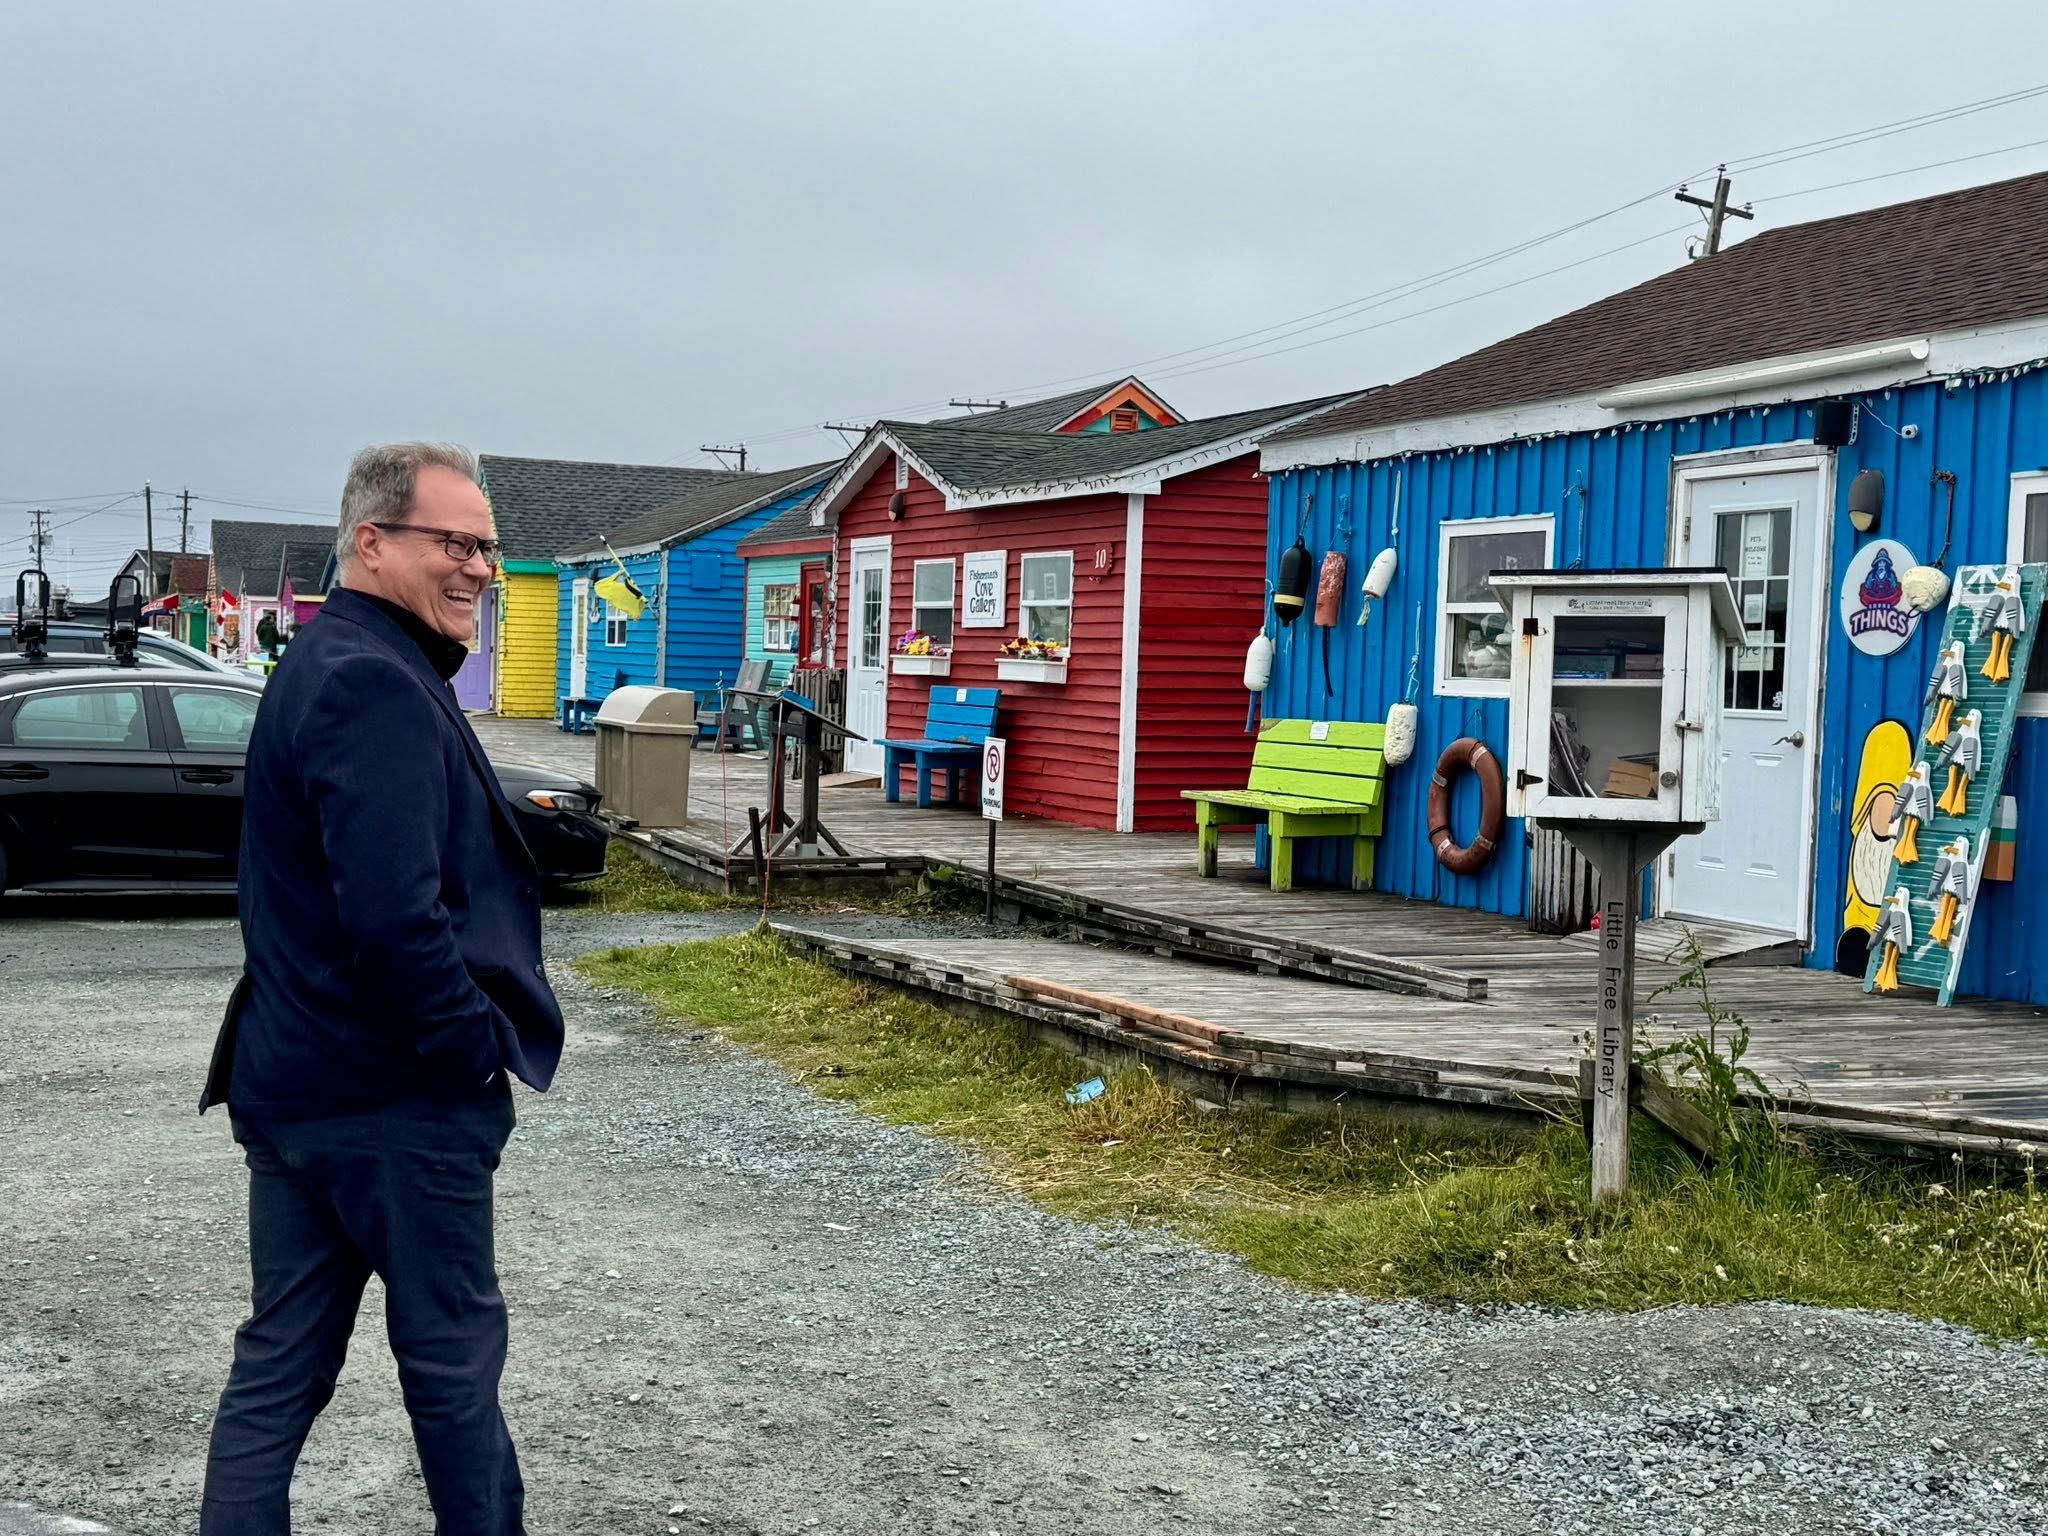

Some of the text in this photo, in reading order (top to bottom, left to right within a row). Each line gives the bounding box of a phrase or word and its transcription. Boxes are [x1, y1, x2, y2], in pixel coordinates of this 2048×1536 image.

[1095, 549, 1106, 568] 10
[975, 581, 993, 597] Cove
[969, 597, 997, 616] Gallery
[1851, 609, 1909, 636] THINGS
[989, 787, 995, 796] NO
[983, 797, 1001, 809] PARKING
[1597, 901, 1624, 1099] Little Free Library
